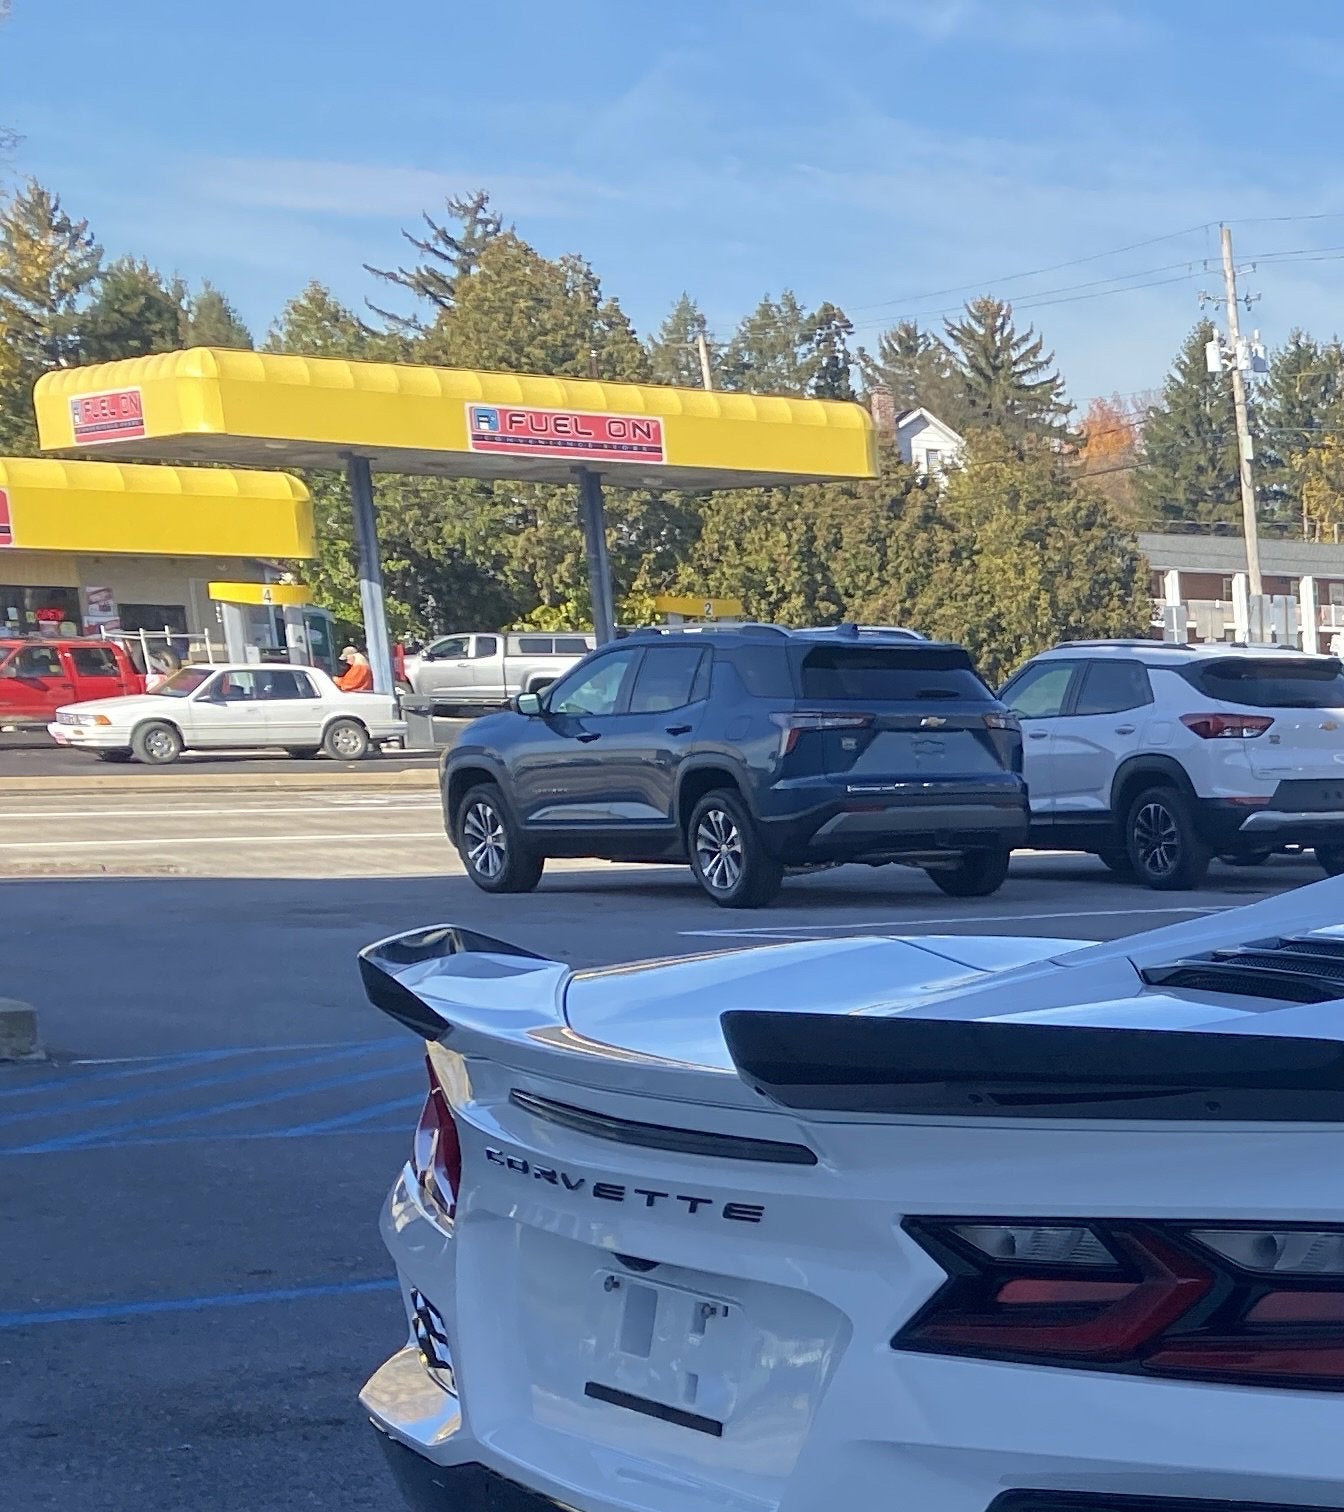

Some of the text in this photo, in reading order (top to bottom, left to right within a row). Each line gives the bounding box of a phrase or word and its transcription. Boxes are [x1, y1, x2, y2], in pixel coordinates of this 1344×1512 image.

[83, 392, 141, 419] FUEL ON
[508, 413, 652, 439] FUEL ON
[264, 589, 272, 603] 4
[704, 602, 712, 615] 2
[485, 1146, 765, 1223] CORVETTE
